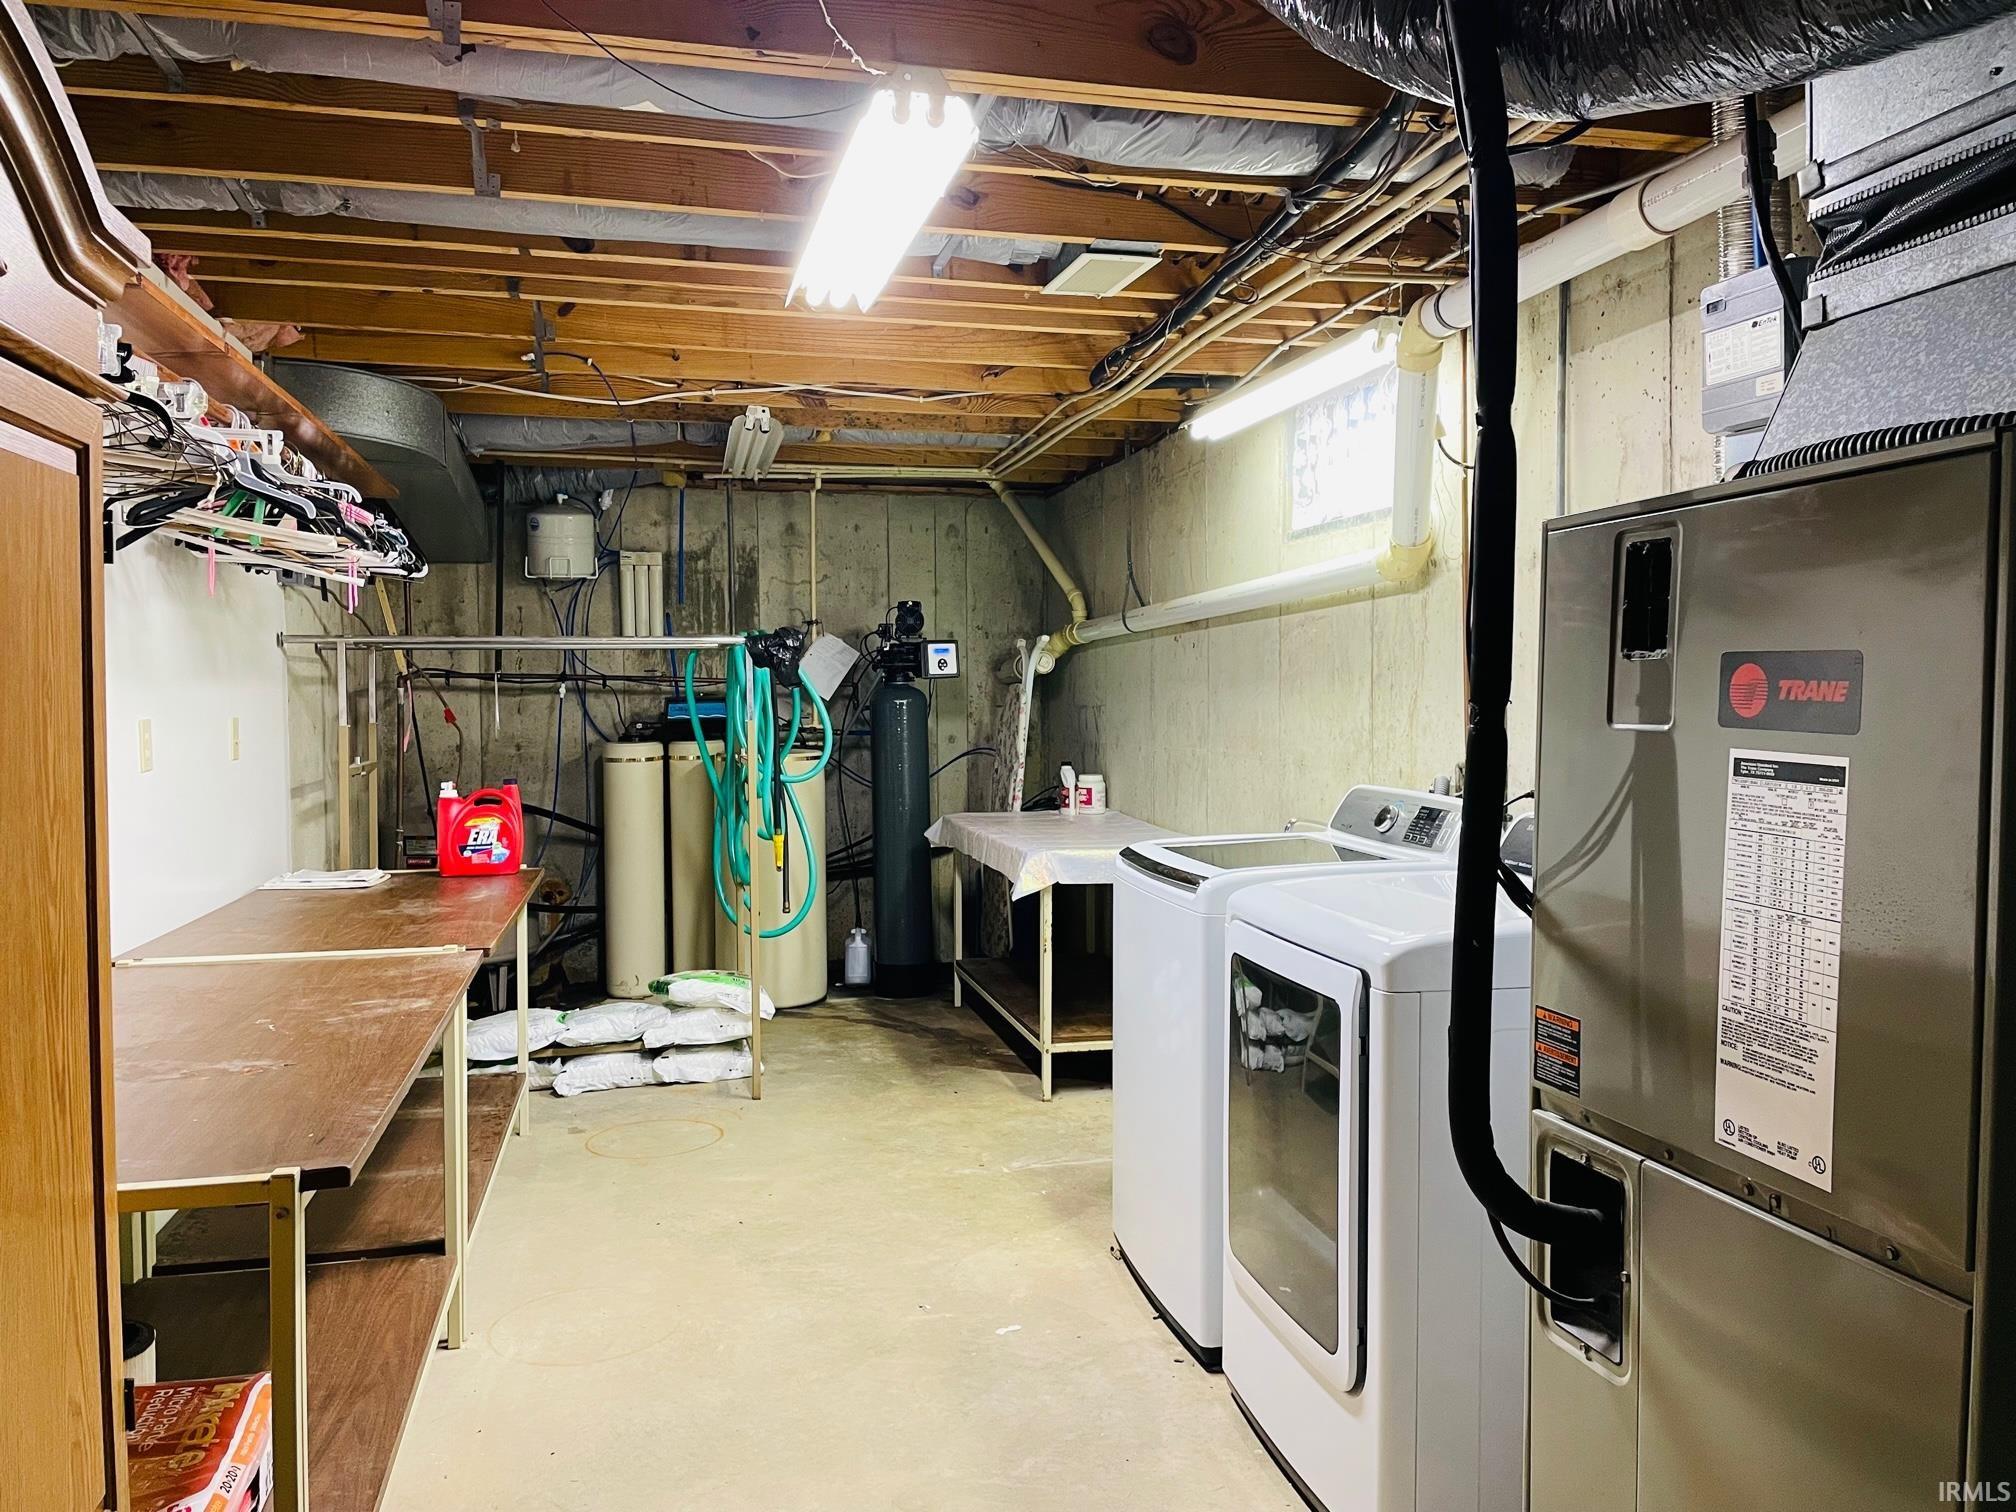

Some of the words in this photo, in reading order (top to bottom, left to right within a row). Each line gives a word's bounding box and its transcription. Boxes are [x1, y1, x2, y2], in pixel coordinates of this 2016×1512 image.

[1778, 679, 1850, 702] TRANE
[467, 828, 498, 845] ERA
[164, 1386, 195, 1418] Micro
